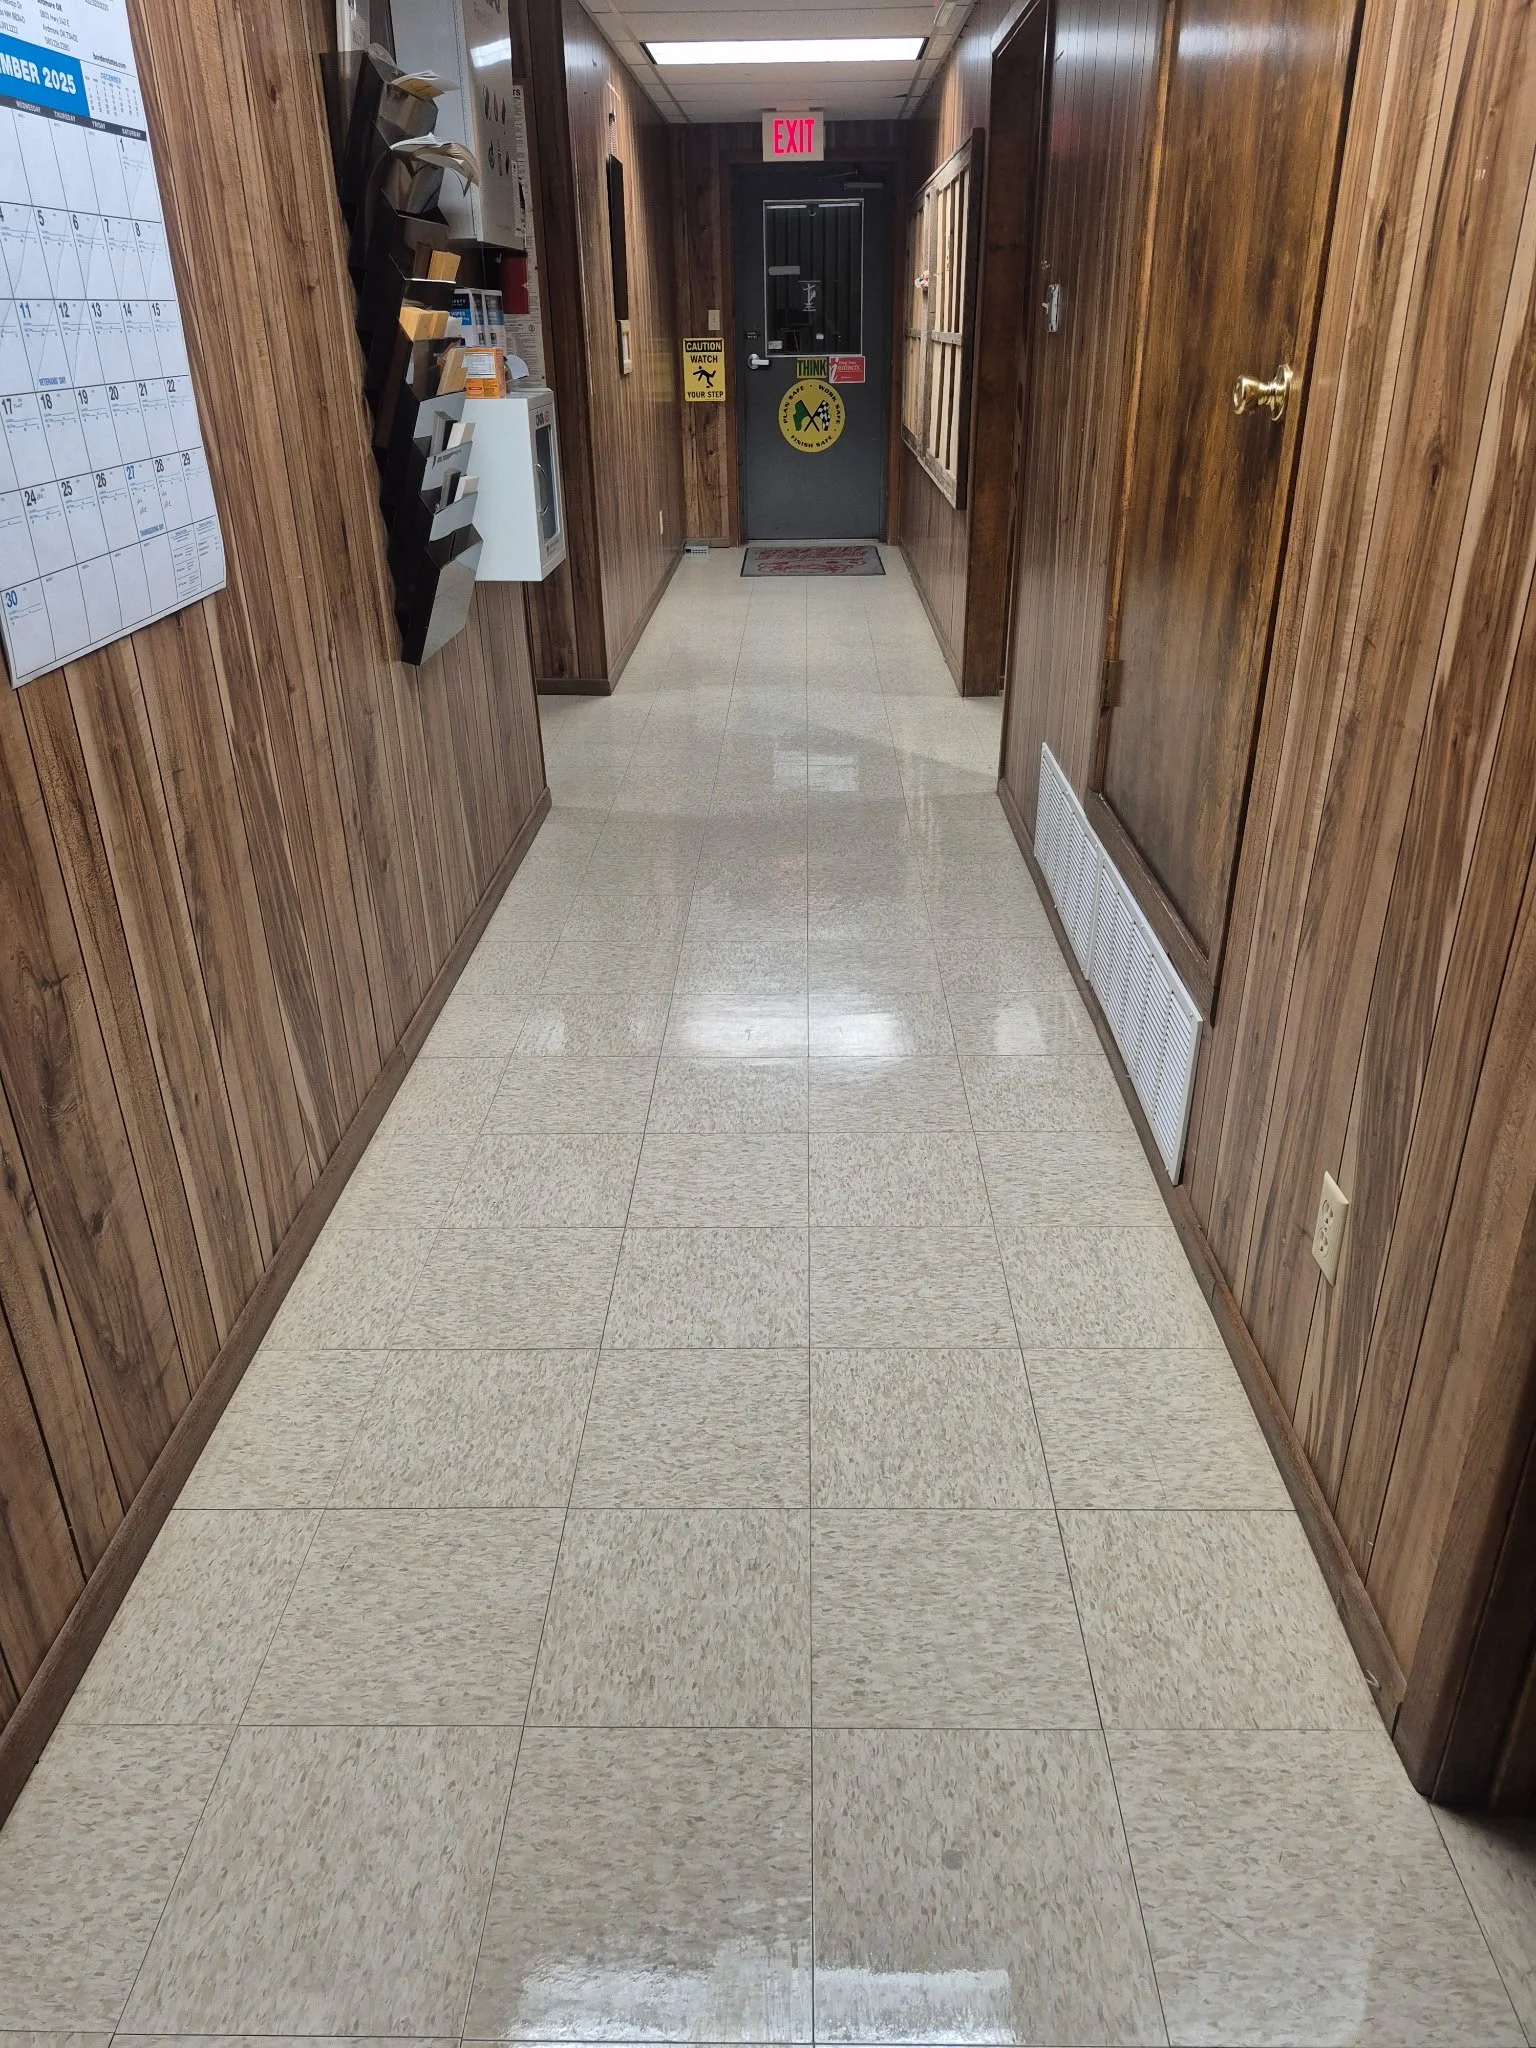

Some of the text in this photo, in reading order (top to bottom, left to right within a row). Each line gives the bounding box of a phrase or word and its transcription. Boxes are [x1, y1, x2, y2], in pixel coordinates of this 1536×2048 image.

[0, 52, 77, 95] MBER 2025
[15, 100, 141, 138] WEDNESDAY THURSDAY FRIDAY SATURDAY
[119, 138, 125, 153] 1
[773, 119, 815, 154] EXIT
[37, 209, 45, 227] 5
[72, 214, 79, 231] 6
[103, 218, 110, 234] 7
[134, 222, 141, 237] 8
[19, 302, 161, 319] 11 12 13 14 15
[686, 341, 722, 351] CAUTION
[690, 355, 718, 364] WATCH
[798, 359, 826, 377] THINK
[1, 398, 13, 415] 17
[40, 393, 53, 410] 18
[78, 389, 89, 405] 19
[108, 385, 119, 401] 20
[138, 382, 149, 397] 21
[166, 379, 176, 393] 22
[687, 391, 724, 399] YOUR STEP
[788, 385, 805, 401] SAFE
[818, 384, 837, 402] WORK
[790, 434, 834, 448] FINISH SAFE
[24, 489, 37, 507] 24
[61, 480, 73, 497] 25
[96, 472, 107, 488] 26
[126, 465, 136, 480] 27
[154, 458, 165, 473] 28
[181, 452, 191, 466] 29
[5, 590, 18, 608] 30
